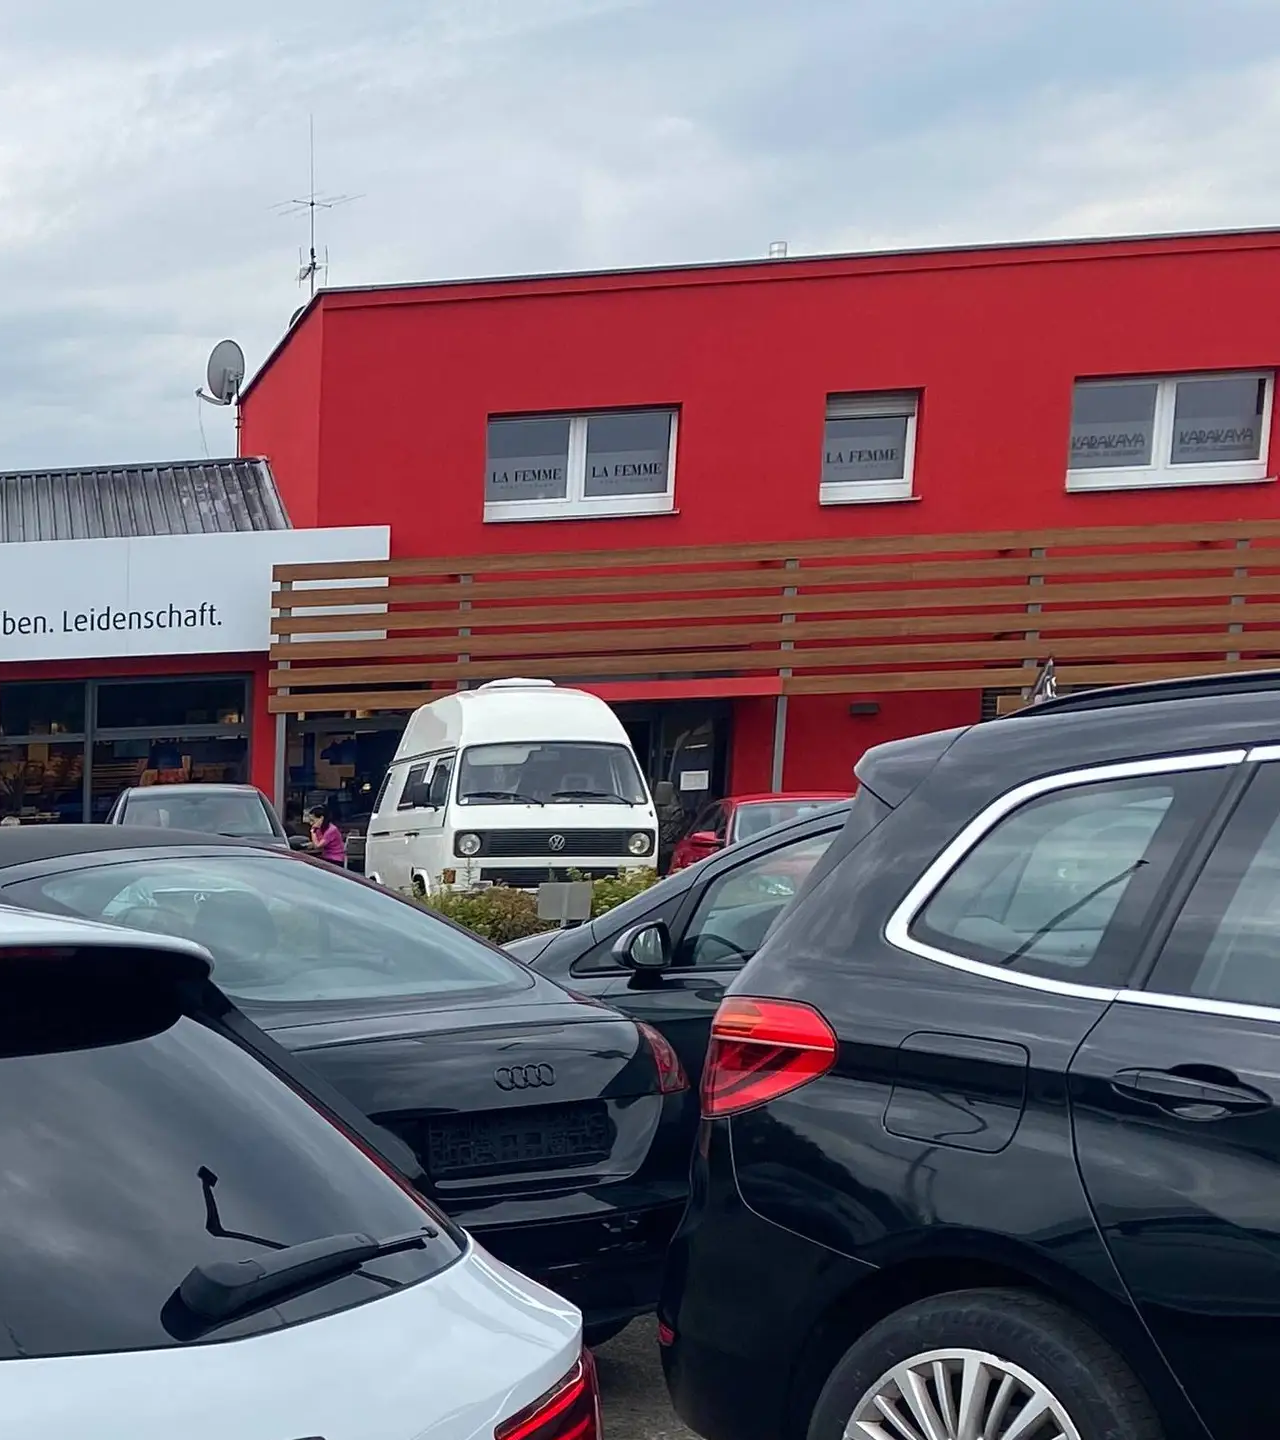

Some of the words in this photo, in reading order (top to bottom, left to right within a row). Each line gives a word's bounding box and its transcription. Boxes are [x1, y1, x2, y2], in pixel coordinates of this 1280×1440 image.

[826, 451, 844, 464] LA
[849, 448, 900, 463] FEMME
[492, 470, 509, 484] LA
[514, 468, 562, 483] FEMME
[592, 465, 609, 479] LA
[614, 462, 662, 477] FEMME
[62, 602, 223, 633] Leidenschaft.
